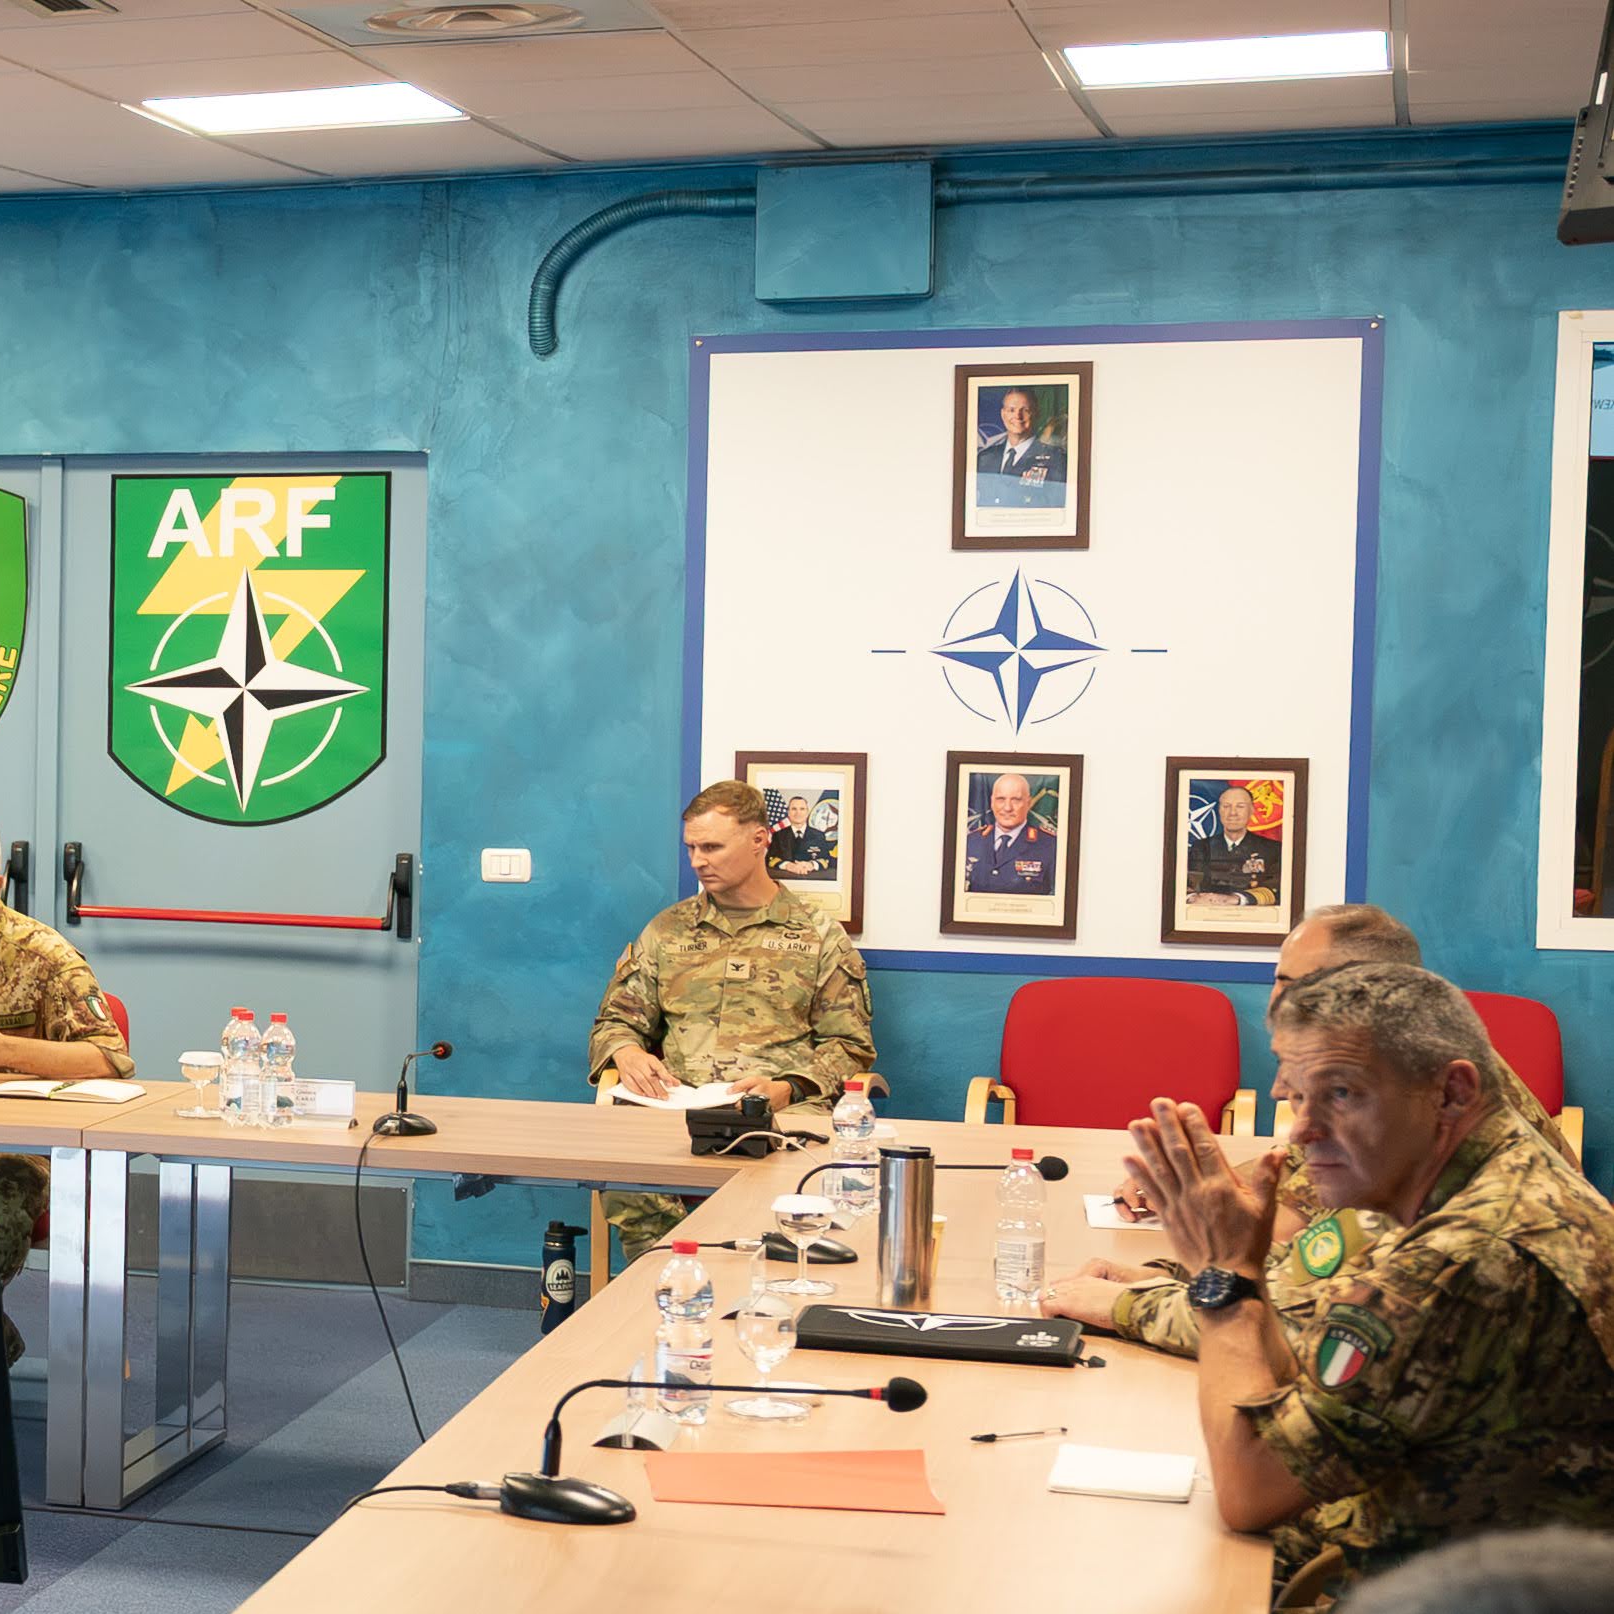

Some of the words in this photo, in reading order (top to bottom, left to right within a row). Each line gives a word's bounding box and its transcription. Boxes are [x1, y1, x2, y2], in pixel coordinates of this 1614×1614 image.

[146, 486, 336, 559] ARF
[679, 941, 708, 952] TURNER
[787, 942, 813, 952] ARMY
[1330, 1329, 1370, 1354] ITALIA
